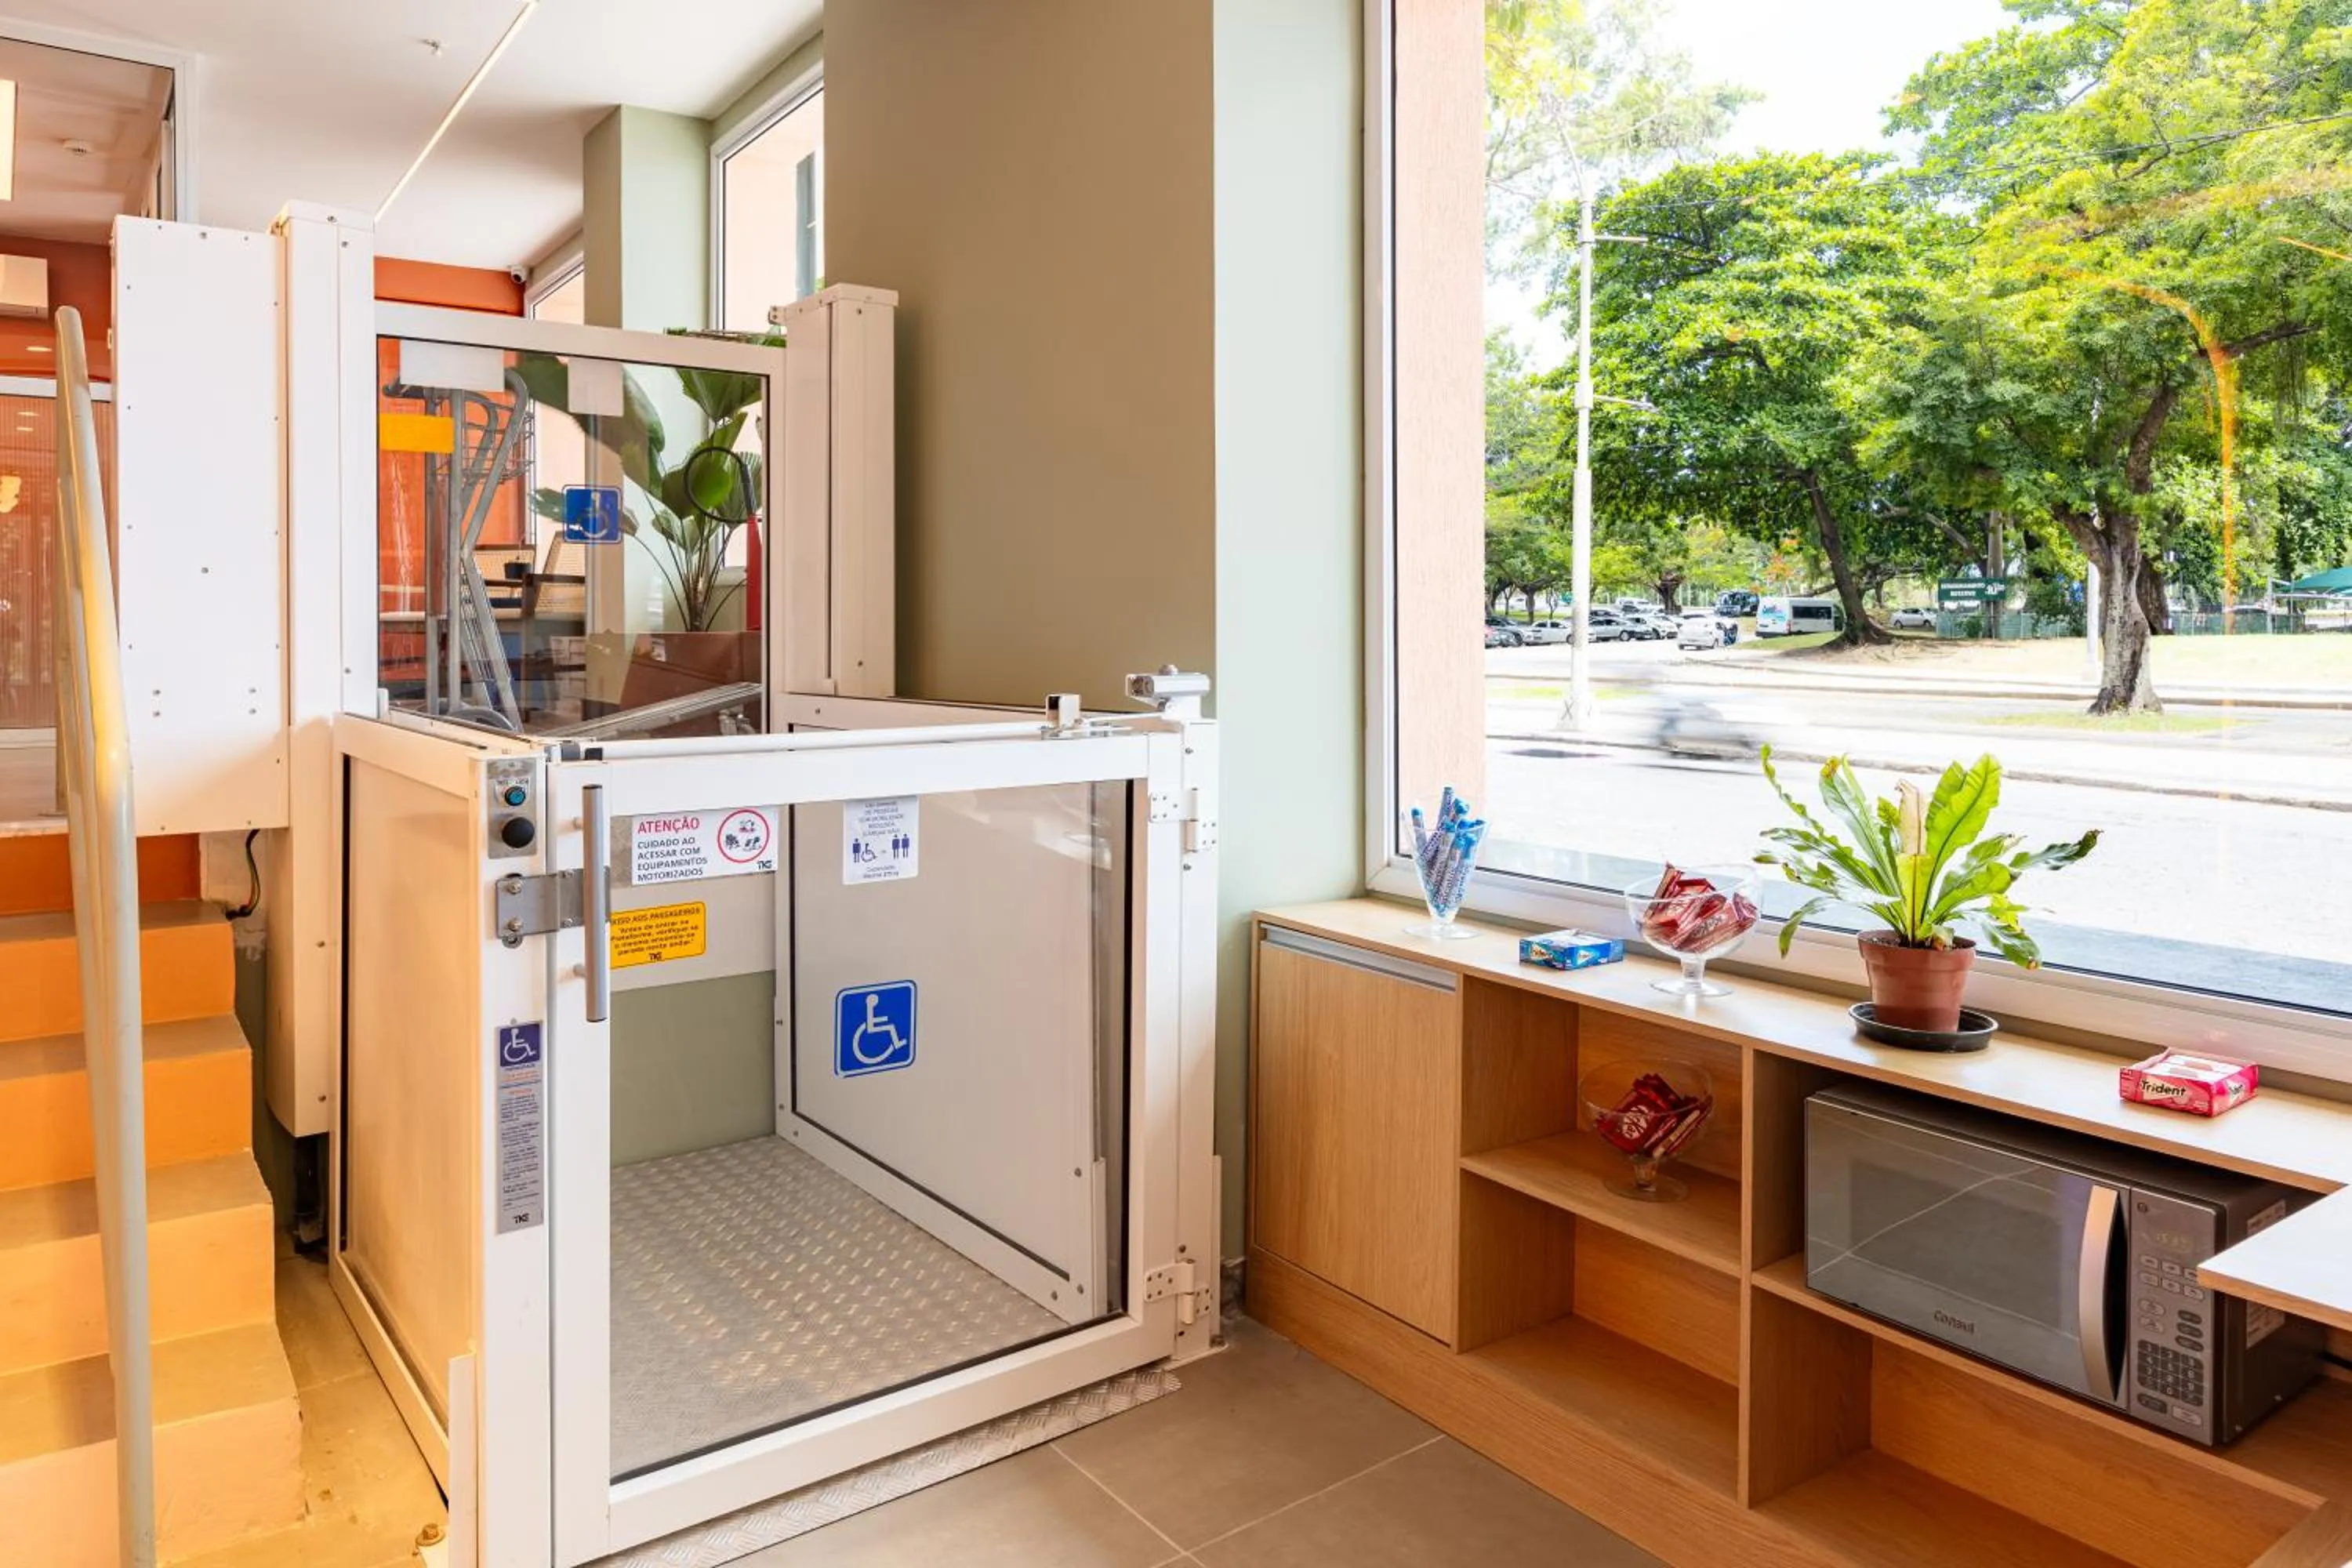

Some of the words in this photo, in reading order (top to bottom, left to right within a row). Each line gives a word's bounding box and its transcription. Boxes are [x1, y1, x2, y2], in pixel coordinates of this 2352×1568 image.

[637, 815, 700, 834] ATENÇÃO
[637, 838, 680, 849] CUIDADO
[681, 837, 696, 845] AO
[637, 849, 677, 860] ACESSAR
[680, 847, 701, 855] COM
[637, 857, 708, 871] EQUIPAMENTOS
[637, 869, 703, 882] MOTORIZADOS
[2141, 1080, 2187, 1097] Trident
[1933, 1309, 1975, 1334] Consul
